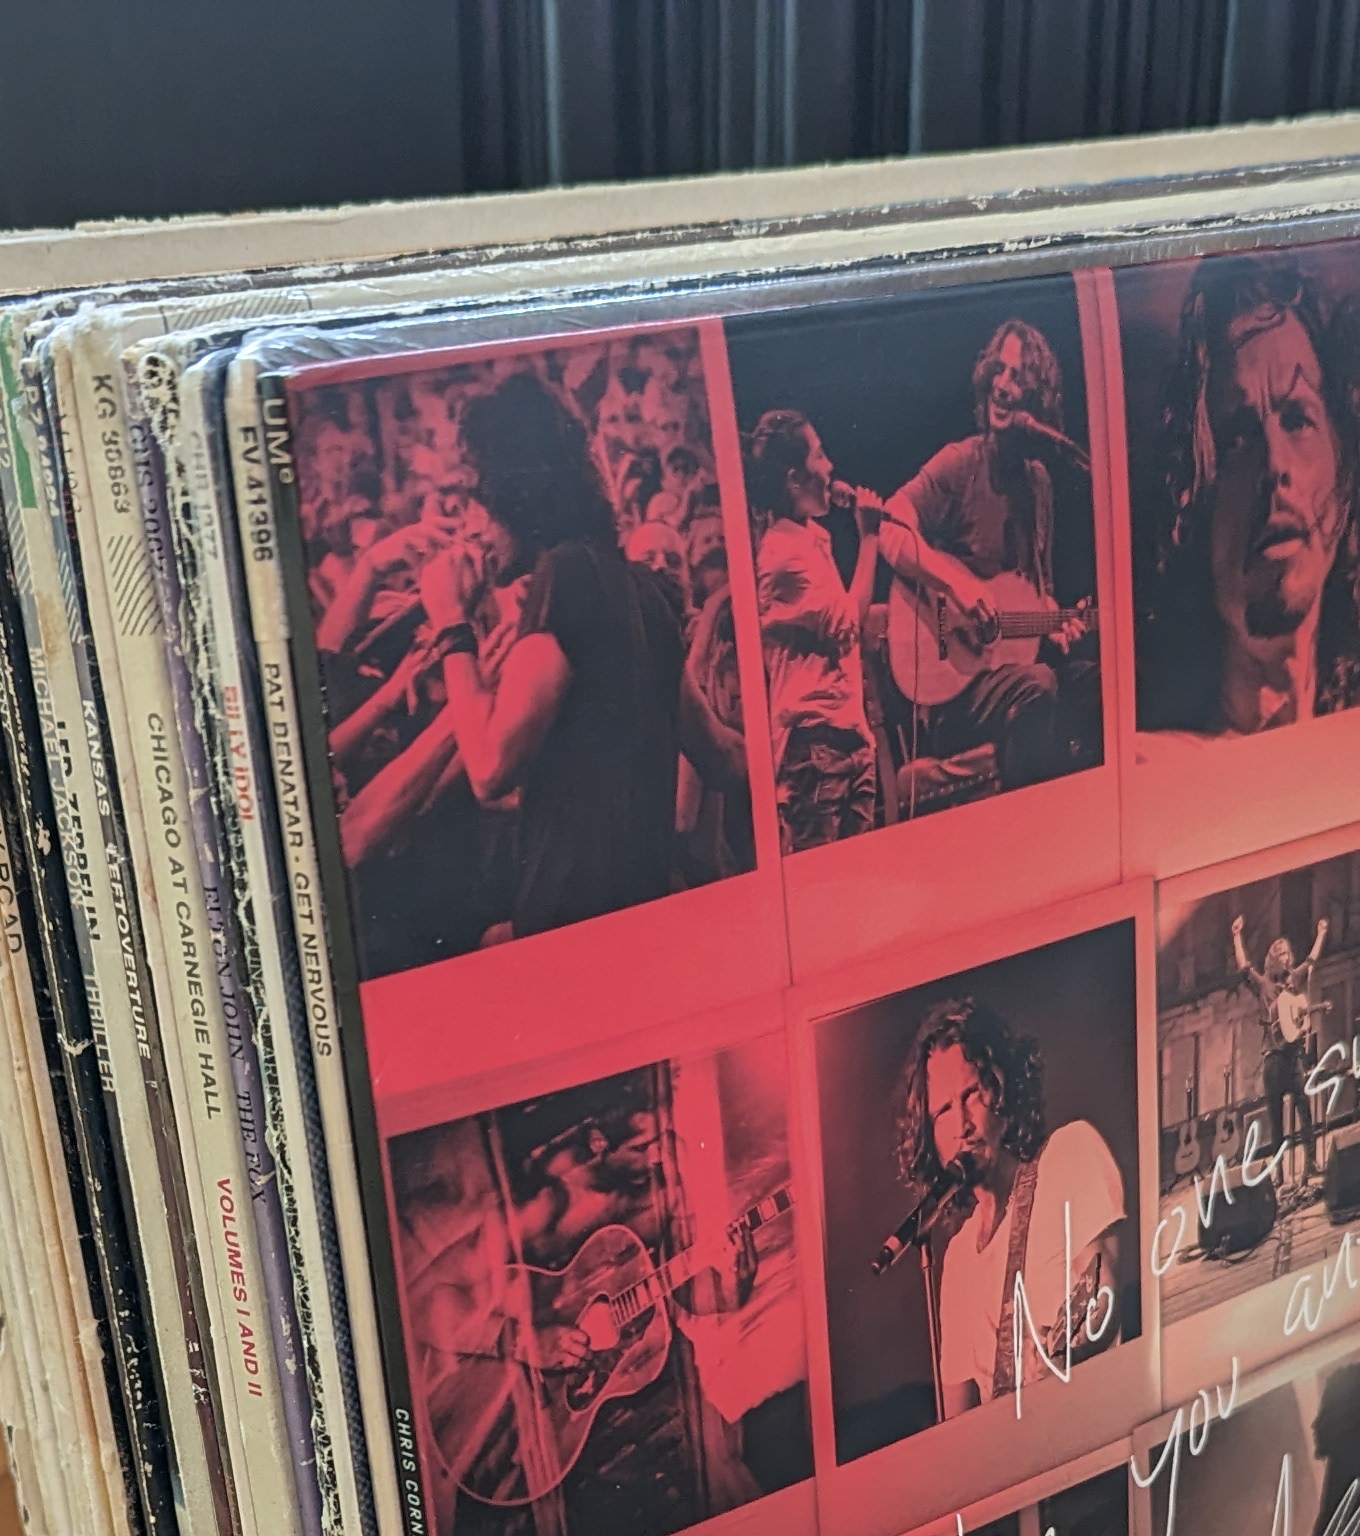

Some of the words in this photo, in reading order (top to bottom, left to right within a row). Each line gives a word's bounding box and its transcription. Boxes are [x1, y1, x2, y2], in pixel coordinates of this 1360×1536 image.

[92, 374, 118, 420] KG
[247, 476, 275, 562] 41396
[224, 686, 247, 765] BILLY
[264, 662, 286, 719] PAT
[147, 712, 182, 848] CHICAGO
[233, 768, 255, 821] IDOL
[272, 721, 304, 848] BENATAR
[28, 648, 60, 767] MICHAEL
[50, 771, 84, 908] JACKSON
[84, 974, 115, 1093] THRILLER
[82, 699, 110, 817] KANSAS
[107, 848, 151, 1060] LEFTOVERTURE
[168, 857, 189, 894] AT
[293, 871, 315, 925] GET
[176, 901, 211, 1045] CARNEGIE
[302, 933, 332, 1058] NERVOUS
[220, 986, 244, 1061] JOHN
[198, 1053, 222, 1120] HALL
[237, 1090, 257, 1143] THE
[246, 1151, 266, 1203] FOX
[217, 1179, 247, 1303] VOLUMES
[1012, 1201, 1115, 1420] No
[1150, 1120, 1287, 1276] one
[239, 1325, 259, 1376] AND
[395, 1408, 416, 1471] CHRIS
